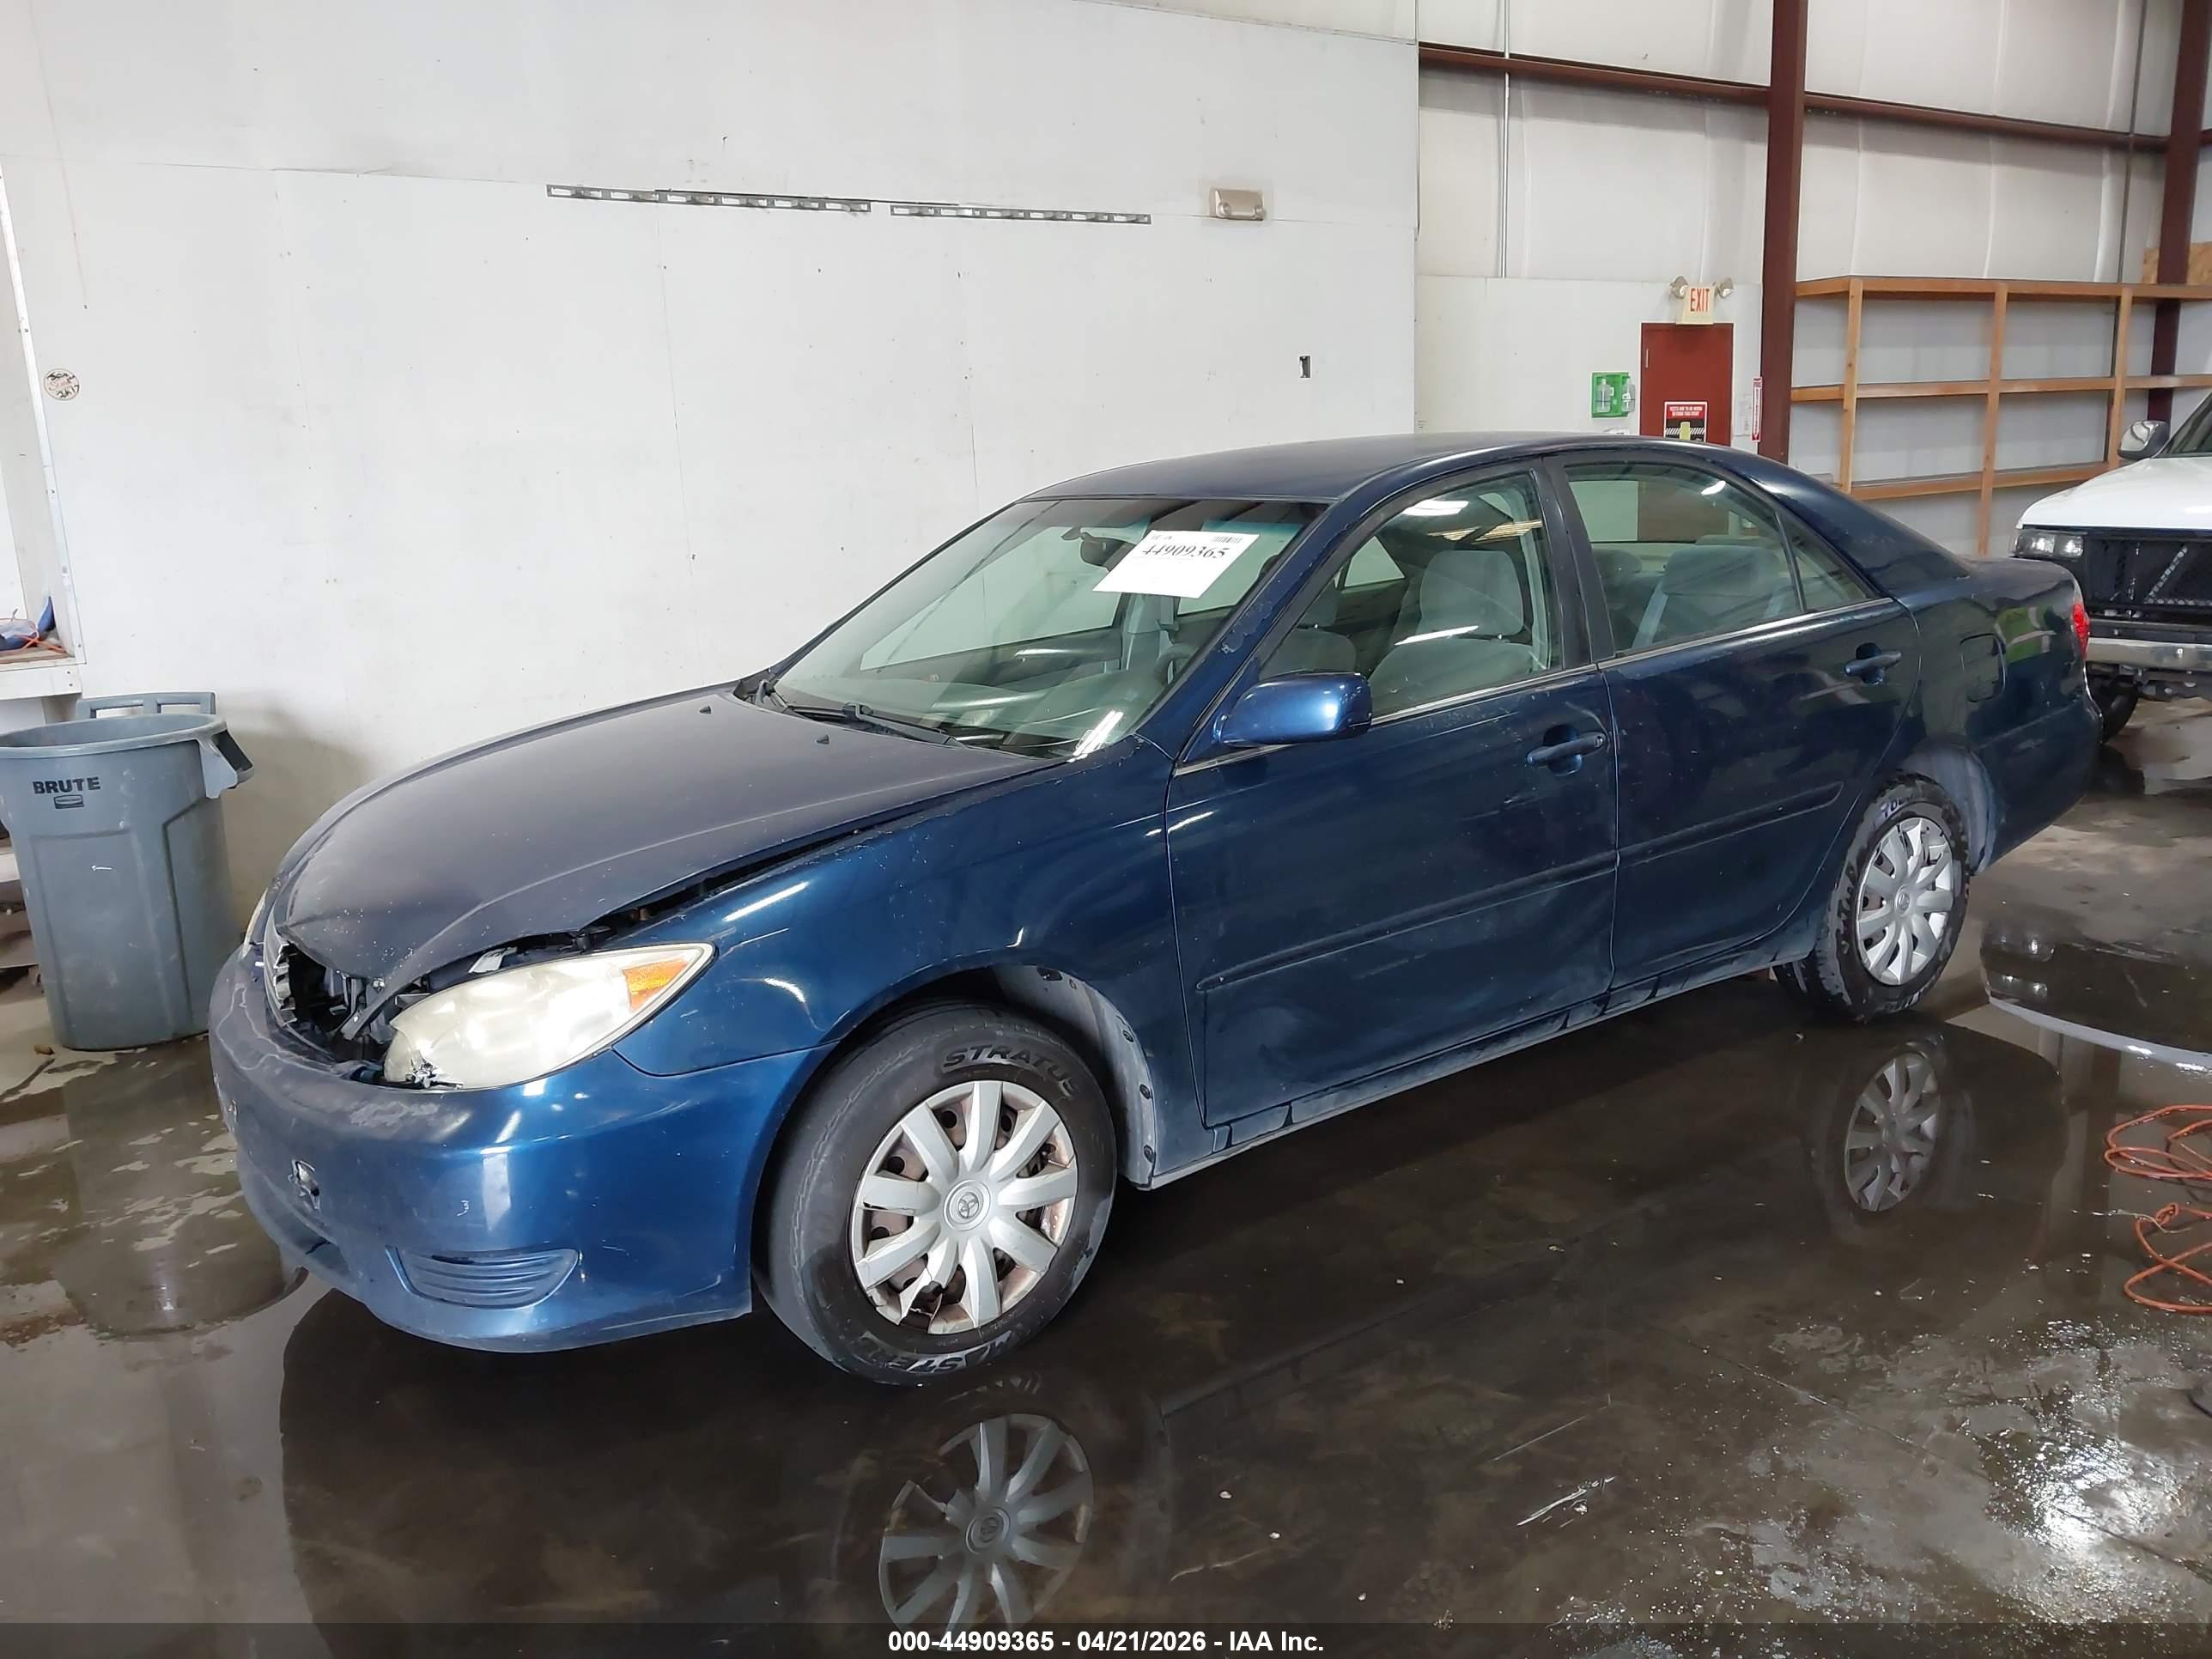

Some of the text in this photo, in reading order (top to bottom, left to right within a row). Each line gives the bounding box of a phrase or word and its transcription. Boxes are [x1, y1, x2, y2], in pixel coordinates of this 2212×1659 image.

[1690, 288, 1711, 313] EXIT
[1142, 544, 1231, 559] 44909365
[33, 776, 101, 794] BRUTE
